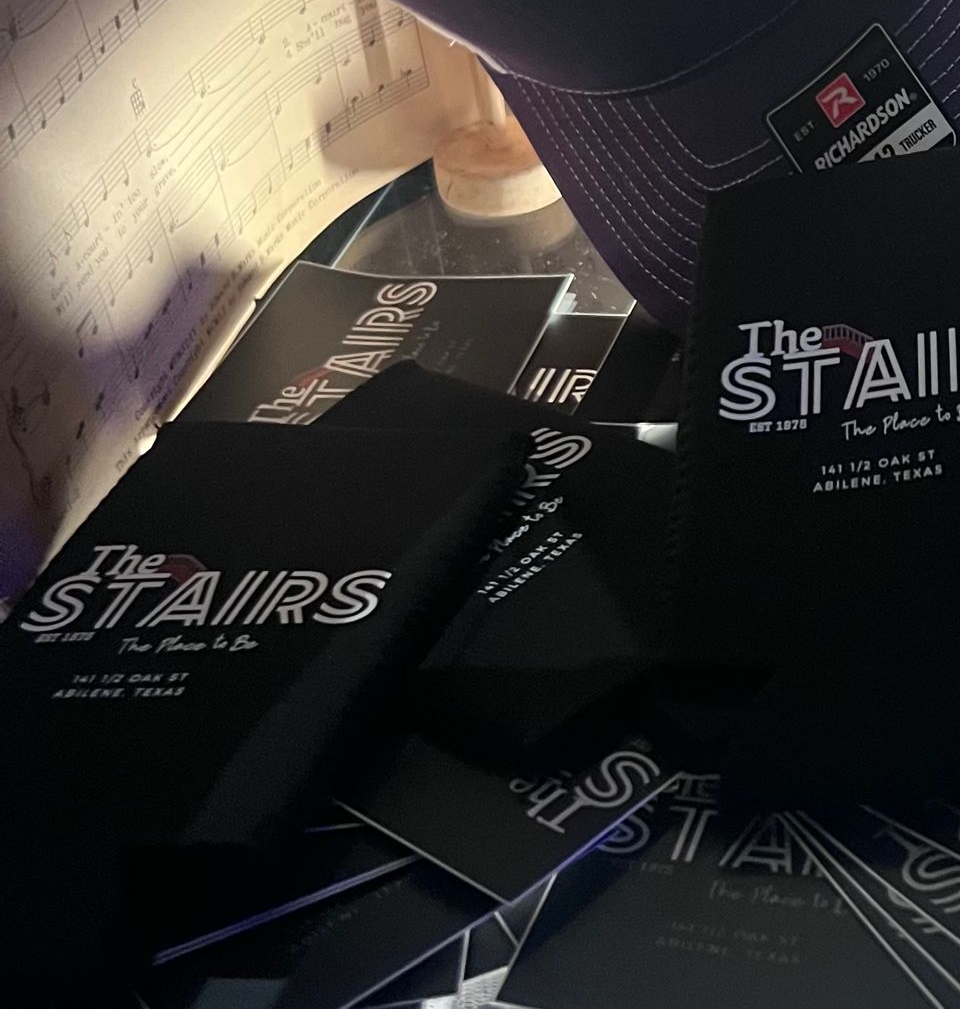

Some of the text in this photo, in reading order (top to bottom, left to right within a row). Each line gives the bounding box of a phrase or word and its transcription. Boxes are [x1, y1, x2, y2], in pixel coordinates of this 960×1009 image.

[793, 57, 891, 142] EST 1970
[814, 88, 912, 171] RICHARDSON
[898, 118, 938, 152] TRUCKER
[738, 320, 823, 359] The
[246, 384, 305, 423] The
[749, 421, 773, 433] EST
[841, 420, 877, 441] The
[883, 411, 931, 435] Place
[937, 404, 952, 422] to
[821, 448, 936, 476] 141 1/2 OAK ST
[894, 464, 943, 485] TEXAS
[537, 495, 565, 514] Be
[82, 544, 167, 579] The
[519, 543, 550, 566] OAK
[546, 530, 565, 544] ST
[543, 531, 584, 562] TEXAS
[20, 569, 393, 633] STAIRS
[118, 636, 153, 655] The
[155, 634, 207, 654] Place
[213, 633, 228, 650] to
[229, 633, 260, 652] Be
[73, 671, 191, 685] 141 1/2 OAK ST
[132, 686, 187, 698] TEXAS
